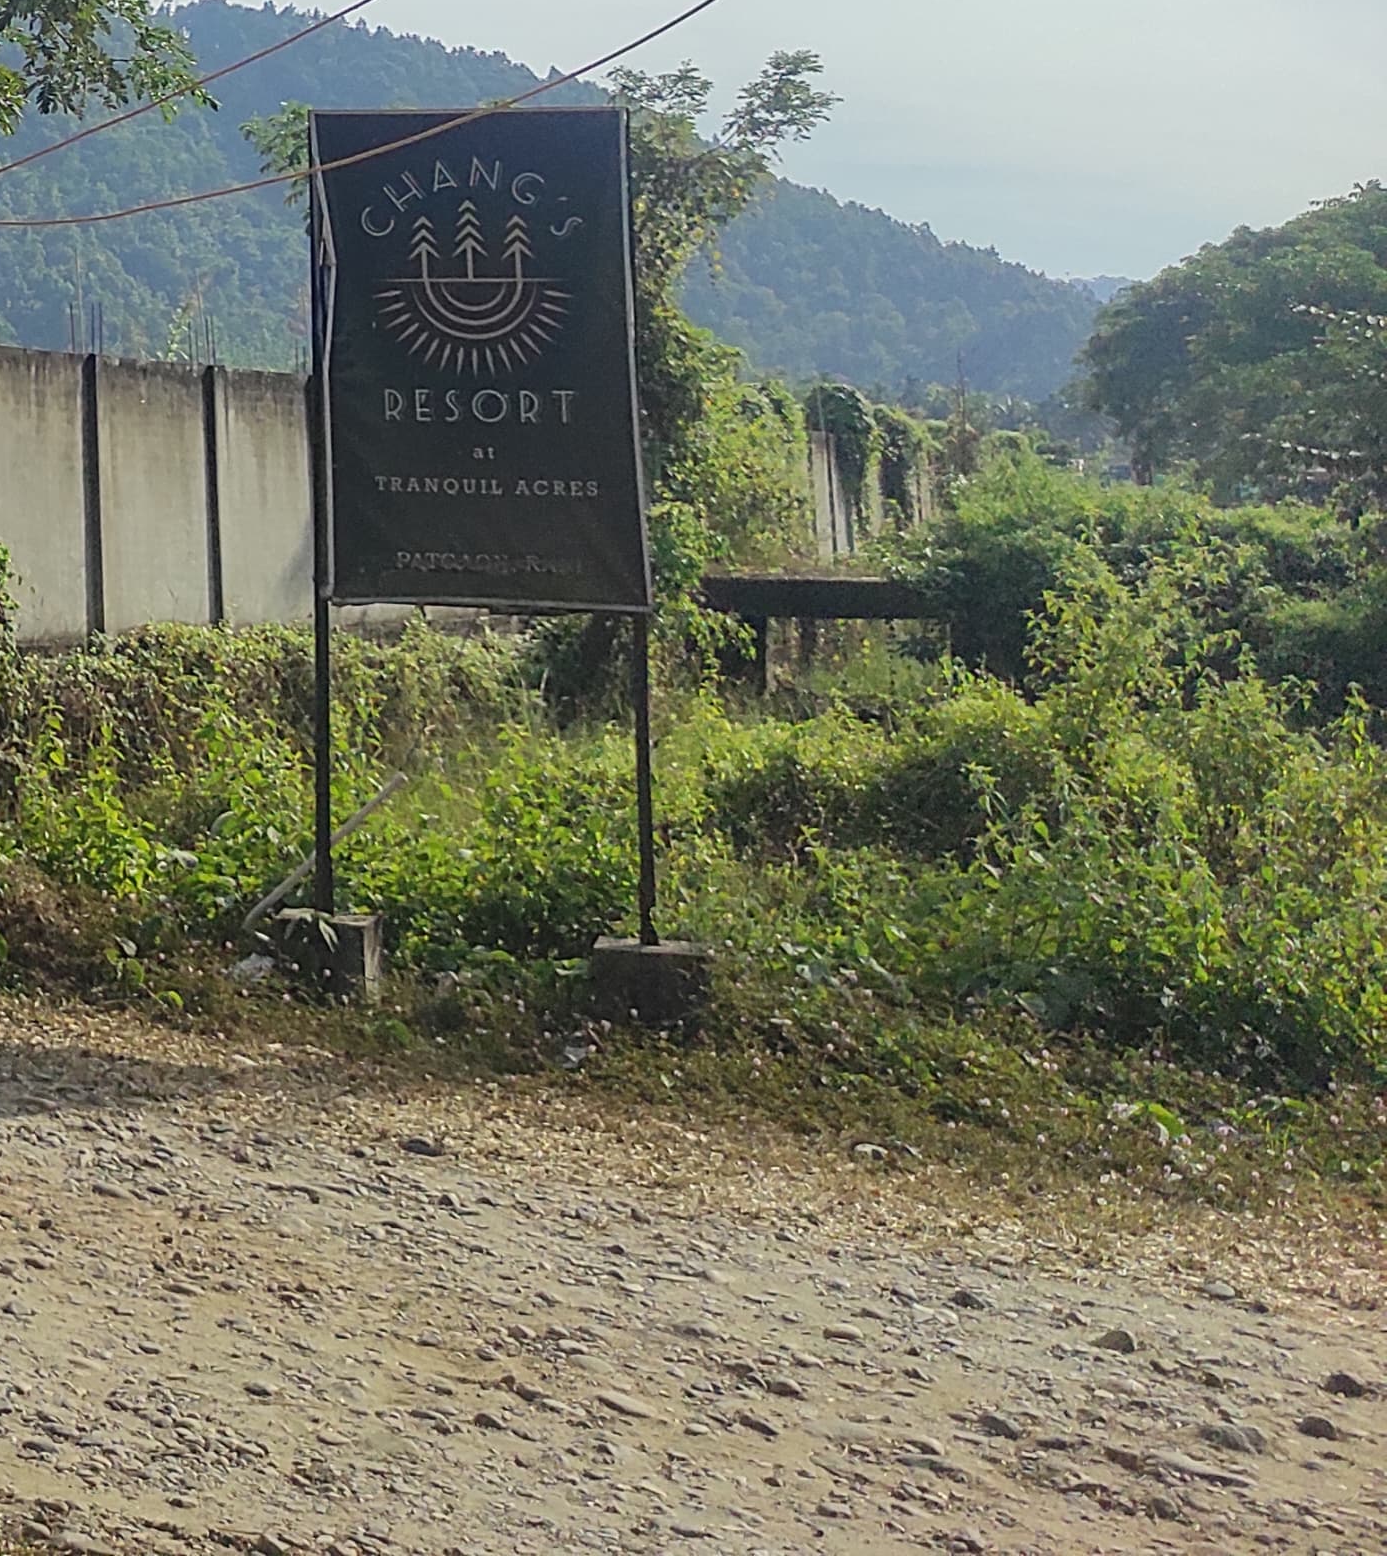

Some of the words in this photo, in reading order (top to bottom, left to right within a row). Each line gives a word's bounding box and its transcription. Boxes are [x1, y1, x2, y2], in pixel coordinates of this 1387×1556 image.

[383, 388, 575, 424] RESORT
[472, 446, 495, 460] at
[374, 475, 504, 495] TRANQUIL
[514, 479, 599, 497] ACRES
